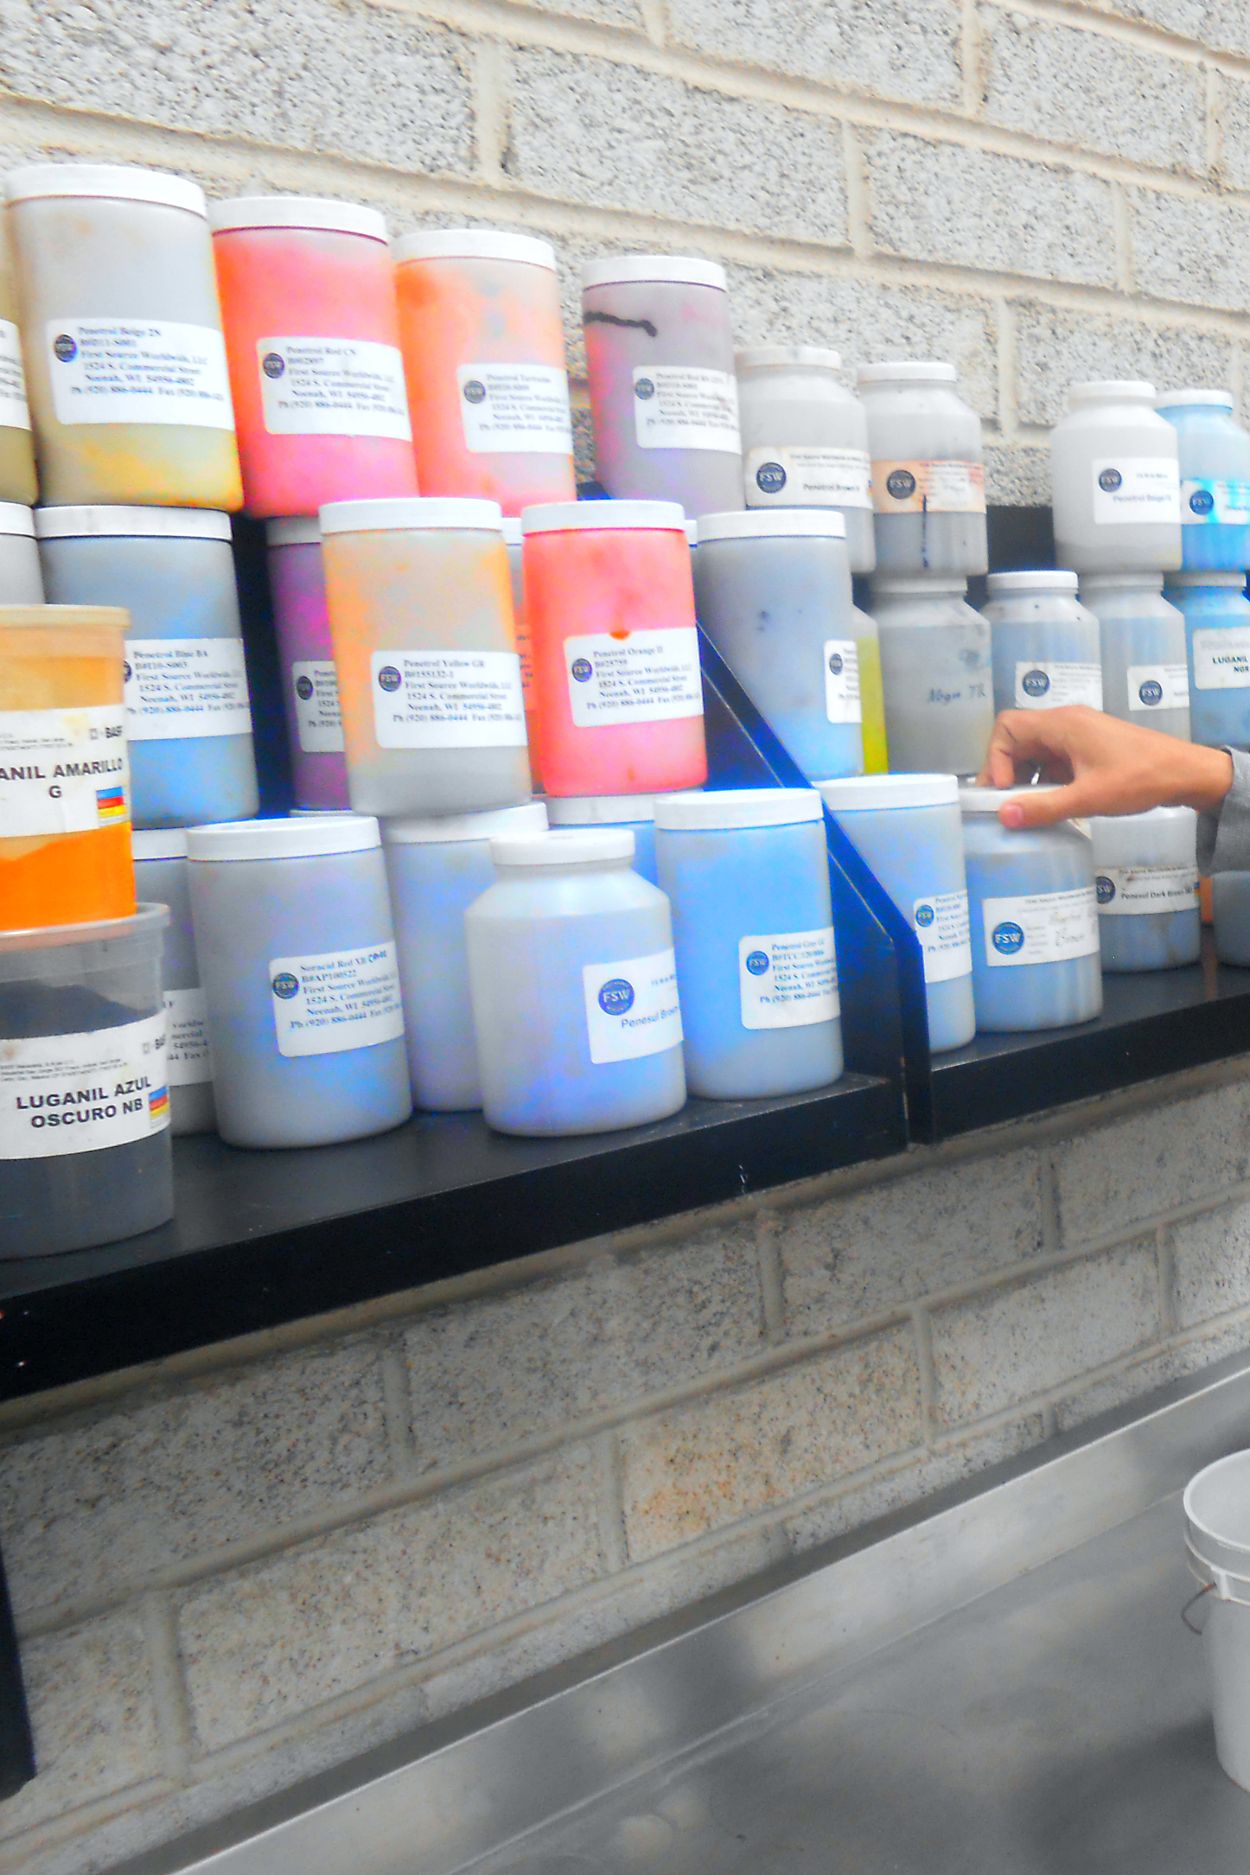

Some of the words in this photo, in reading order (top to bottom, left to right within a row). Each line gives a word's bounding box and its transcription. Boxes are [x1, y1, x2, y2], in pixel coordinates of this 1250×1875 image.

[53, 757, 123, 778] AMARILLO
[49, 784, 62, 799] G
[1097, 884, 1112, 895] SW
[995, 932, 1020, 944] FSW
[603, 990, 630, 1003] FSW
[15, 1087, 110, 1110] LUGANIL
[113, 1076, 152, 1098] AZUL
[30, 1105, 117, 1129] OSCURO
[122, 1097, 143, 1115] NB
